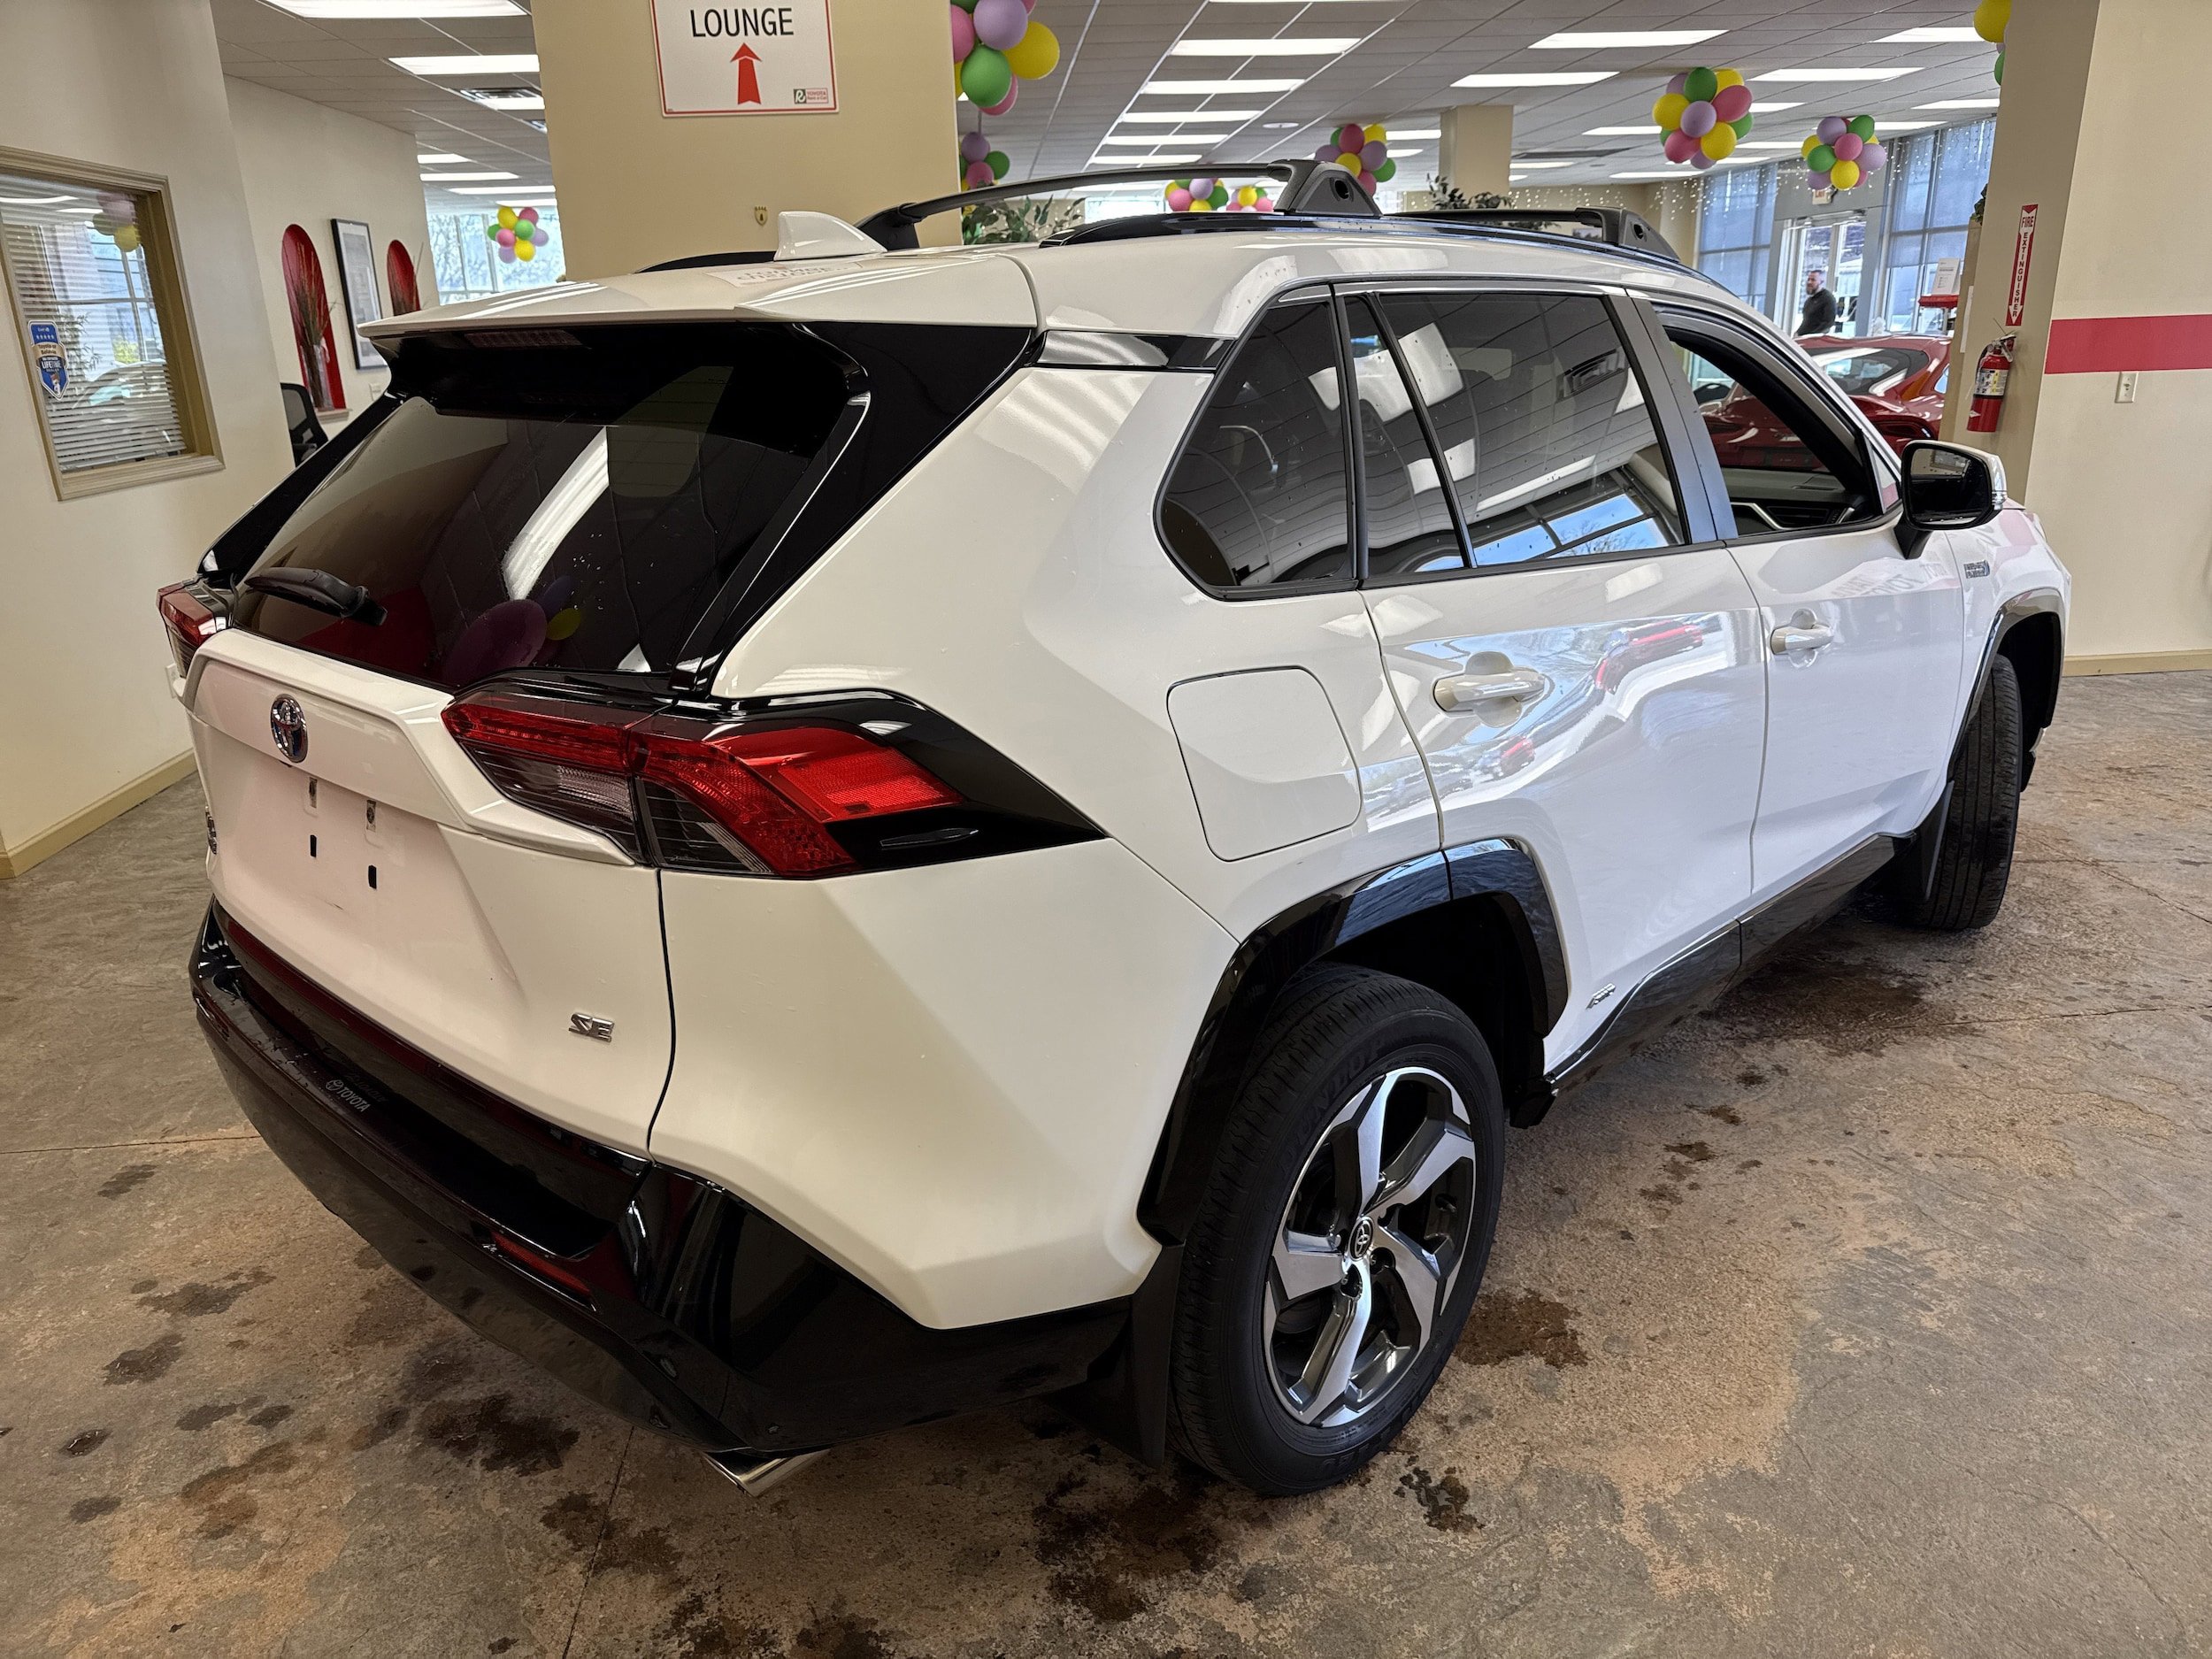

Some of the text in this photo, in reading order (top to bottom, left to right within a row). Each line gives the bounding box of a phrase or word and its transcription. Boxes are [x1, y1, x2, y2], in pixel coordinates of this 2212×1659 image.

[690, 8, 795, 38] LOUNGE
[2021, 216, 2034, 228] FIRE
[2012, 232, 2028, 318] EXTINGUISHER
[569, 1013, 614, 1043] SE
[337, 1087, 371, 1112] TOYOTA
